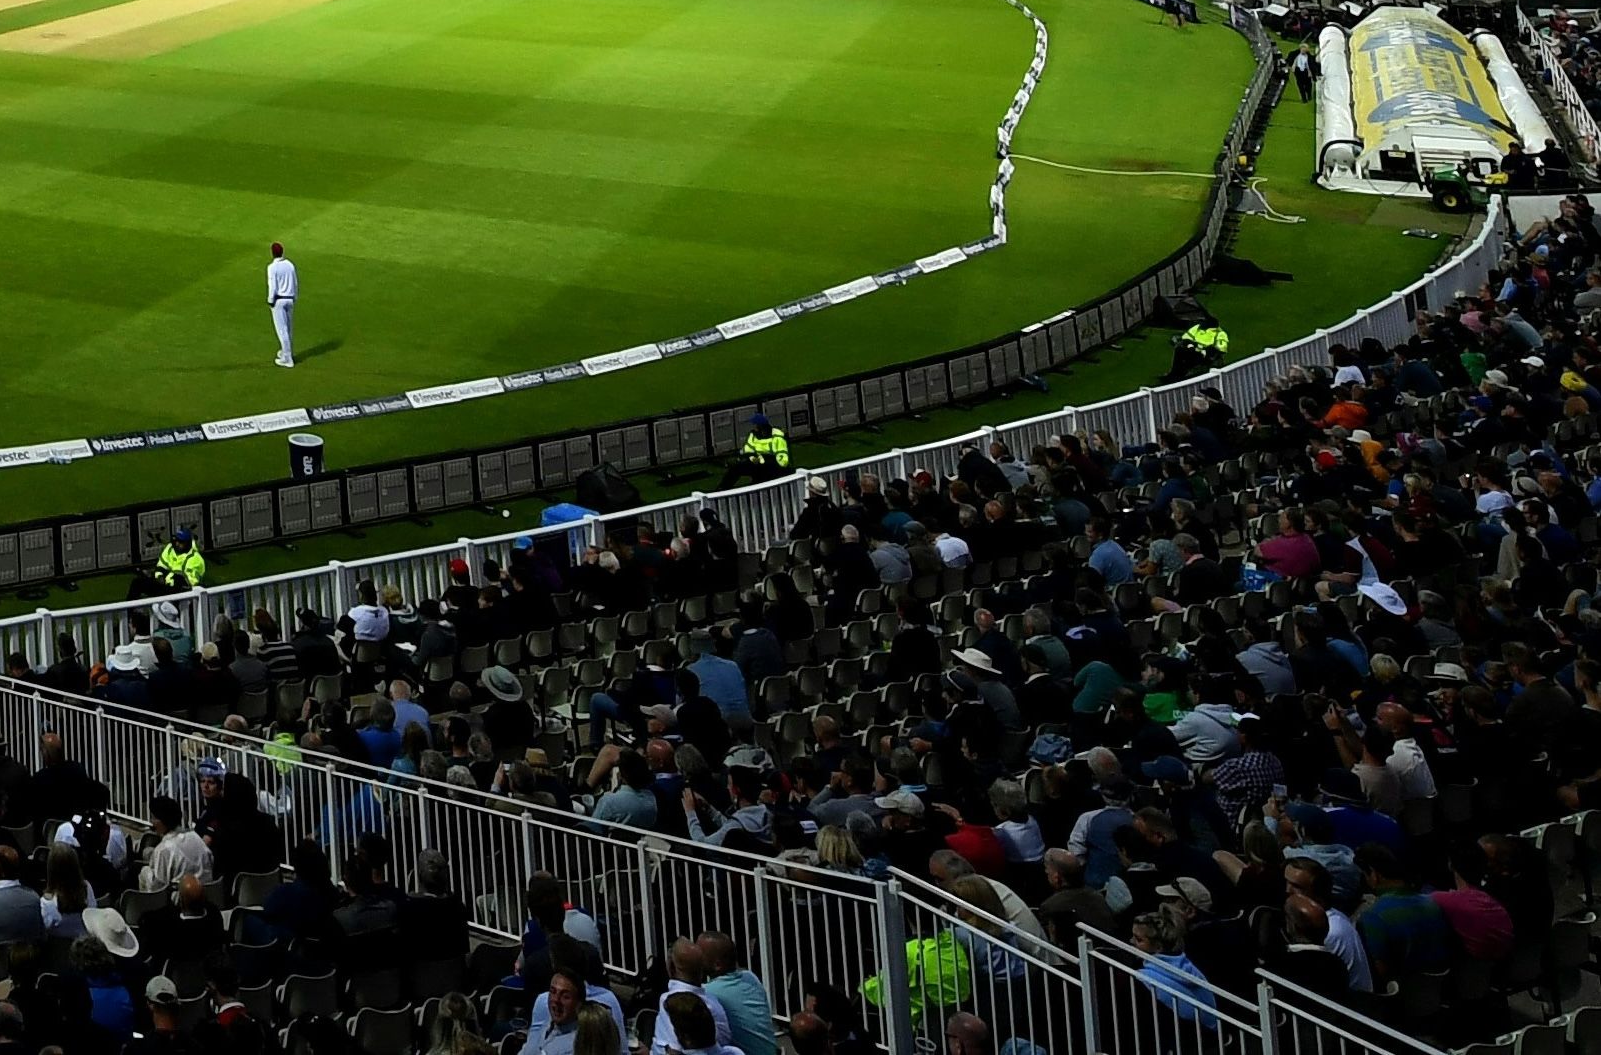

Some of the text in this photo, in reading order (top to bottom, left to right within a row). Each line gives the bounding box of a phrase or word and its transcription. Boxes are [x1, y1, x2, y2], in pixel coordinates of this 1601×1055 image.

[321, 405, 359, 419] Investec
[217, 419, 254, 434] Investec
[100, 429, 202, 450] Investec Private Banking
